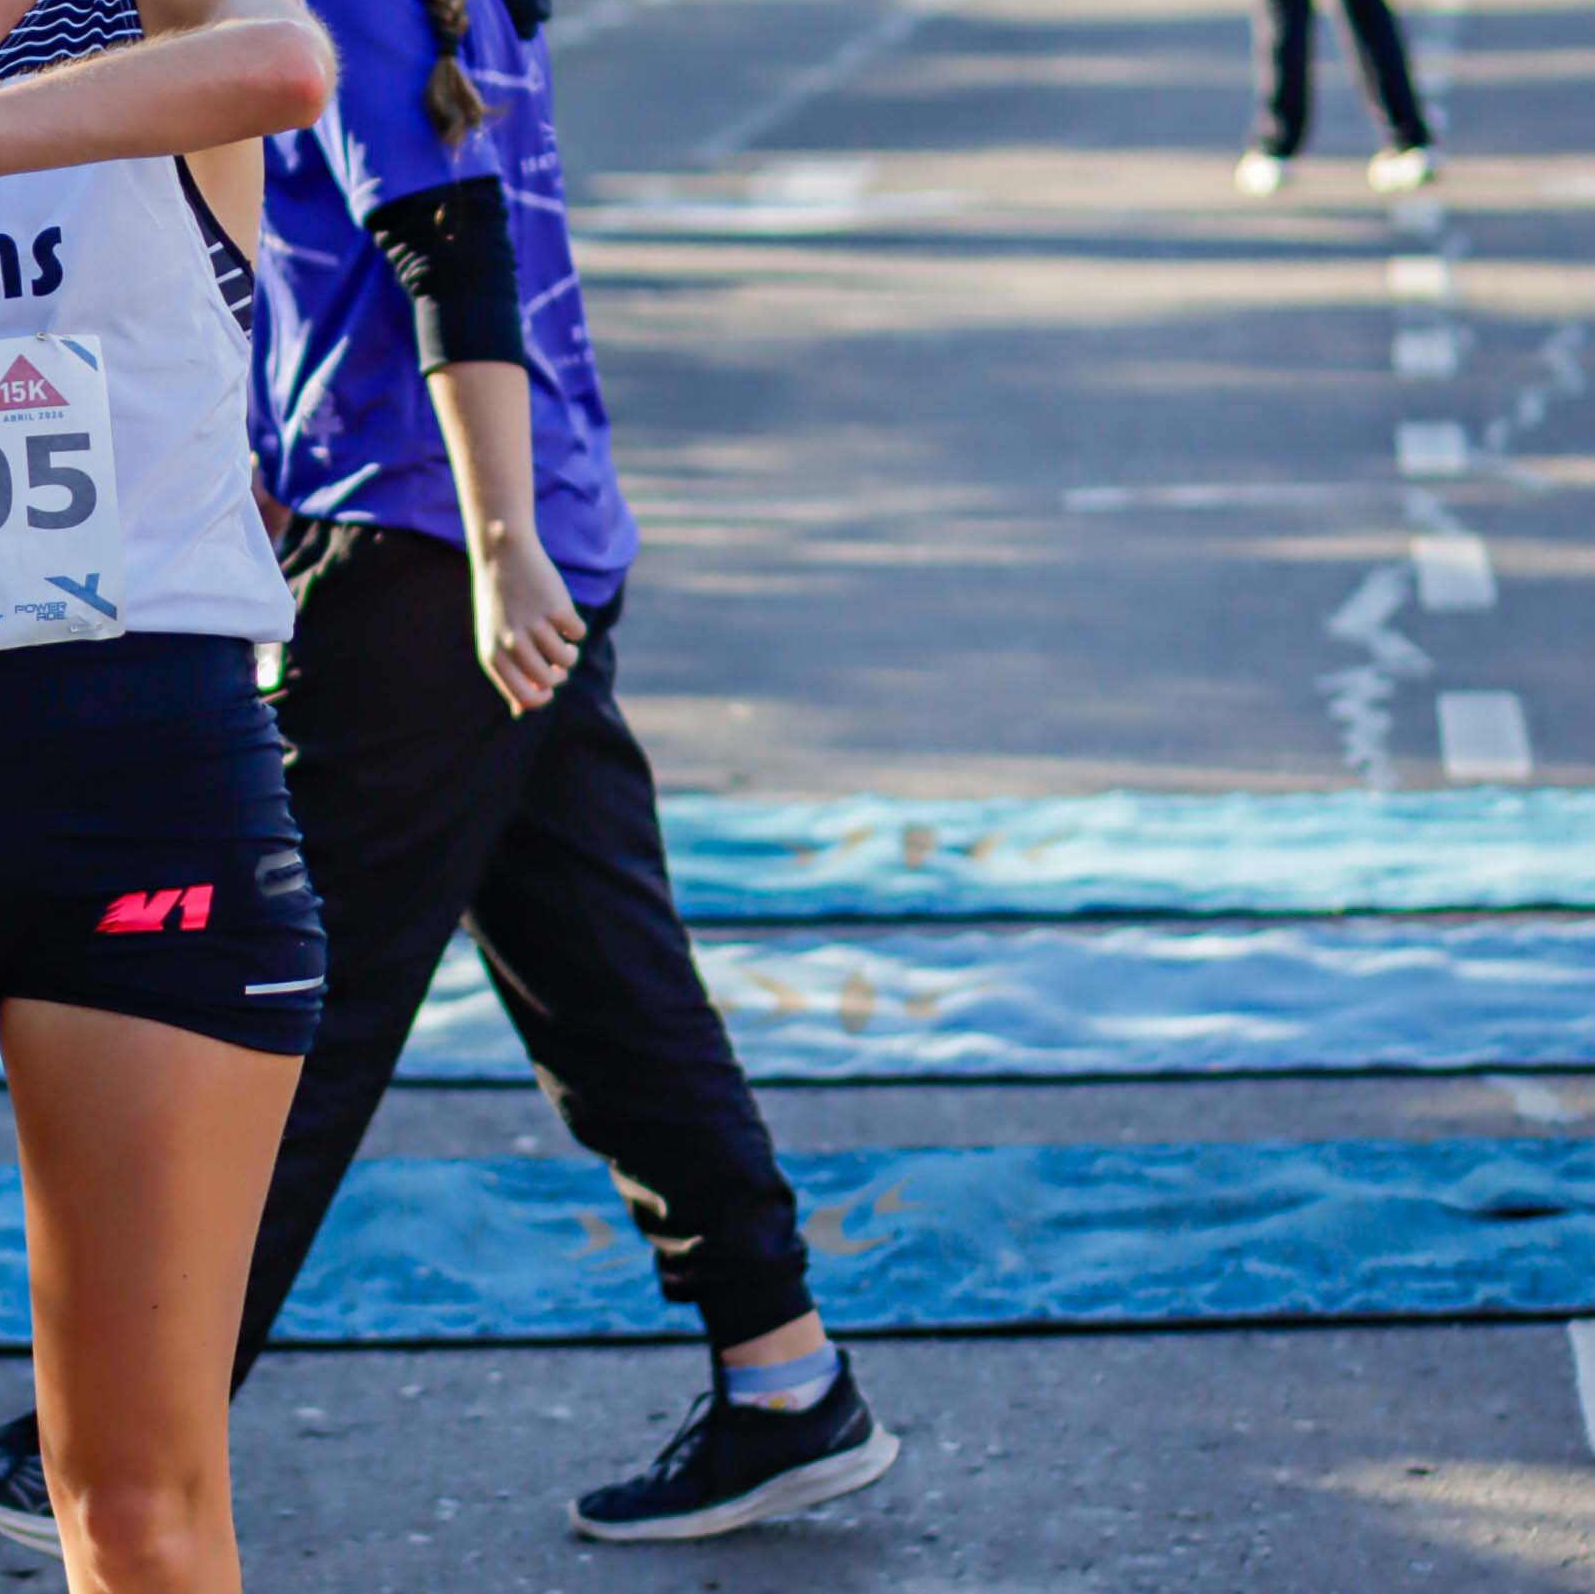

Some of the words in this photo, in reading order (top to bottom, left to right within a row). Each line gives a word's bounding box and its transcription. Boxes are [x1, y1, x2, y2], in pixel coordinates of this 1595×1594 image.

[4, 411, 35, 423] ABRIL
[38, 408, 65, 420] 2026
[14, 601, 68, 616] POWER
[36, 611, 68, 622] ADE
